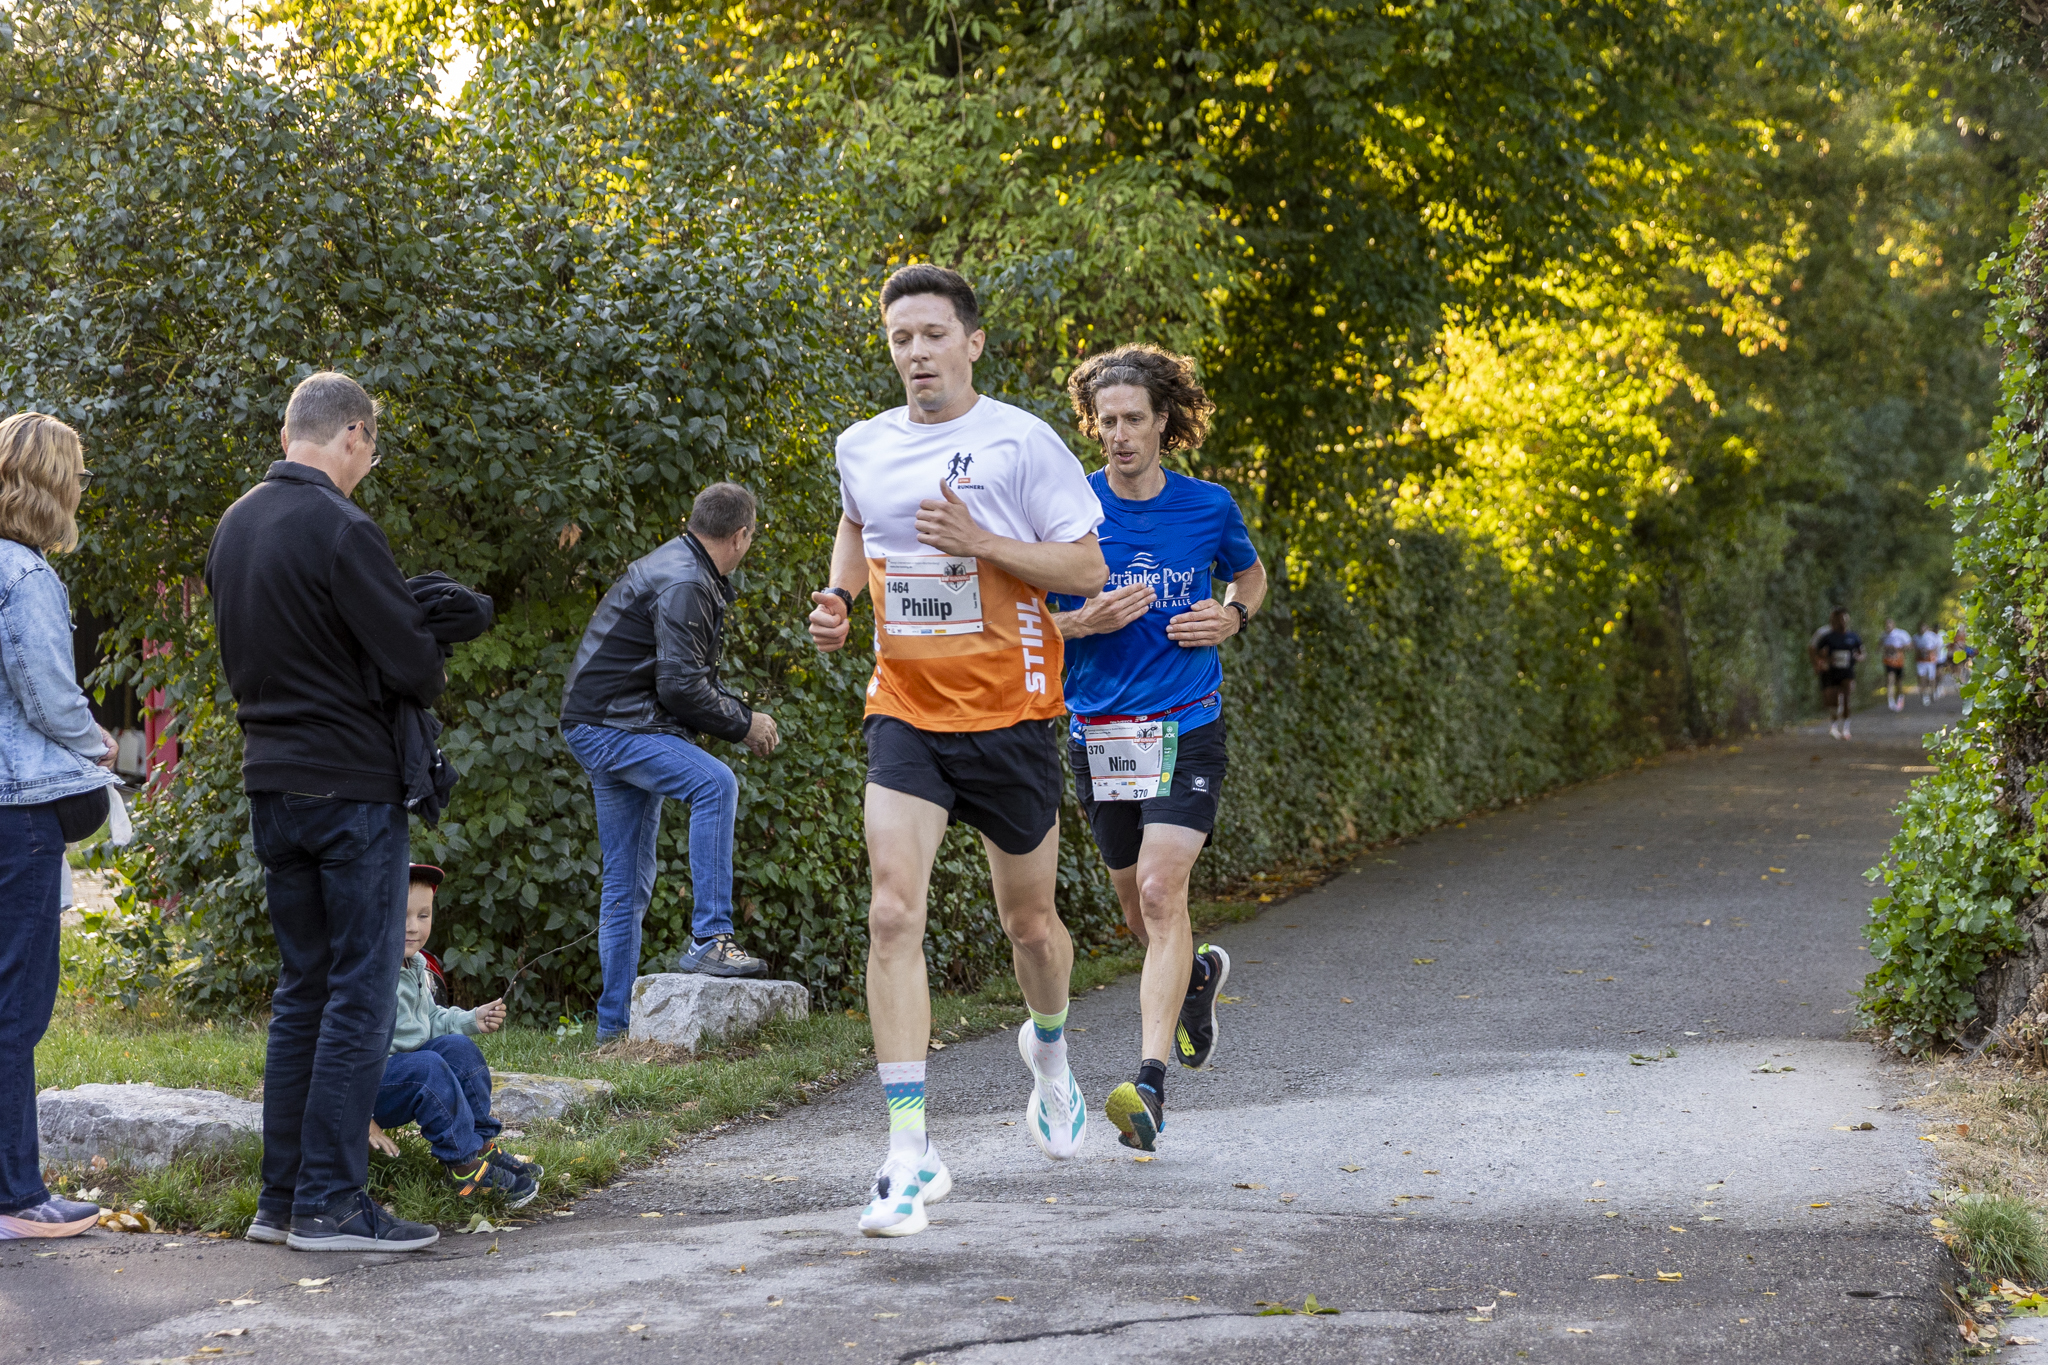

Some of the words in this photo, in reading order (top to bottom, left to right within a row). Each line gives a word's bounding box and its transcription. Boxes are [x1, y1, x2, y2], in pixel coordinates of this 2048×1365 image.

[1105, 569, 1161, 586] etränke
[1163, 567, 1195, 584] Pool
[887, 581, 909, 593] 1464
[902, 597, 952, 621] Philip
[1171, 599, 1192, 607] ALLE
[1016, 597, 1046, 695] STIHL
[1088, 745, 1104, 755] 370
[1108, 756, 1137, 772] Nino
[1133, 789, 1148, 798] 370
